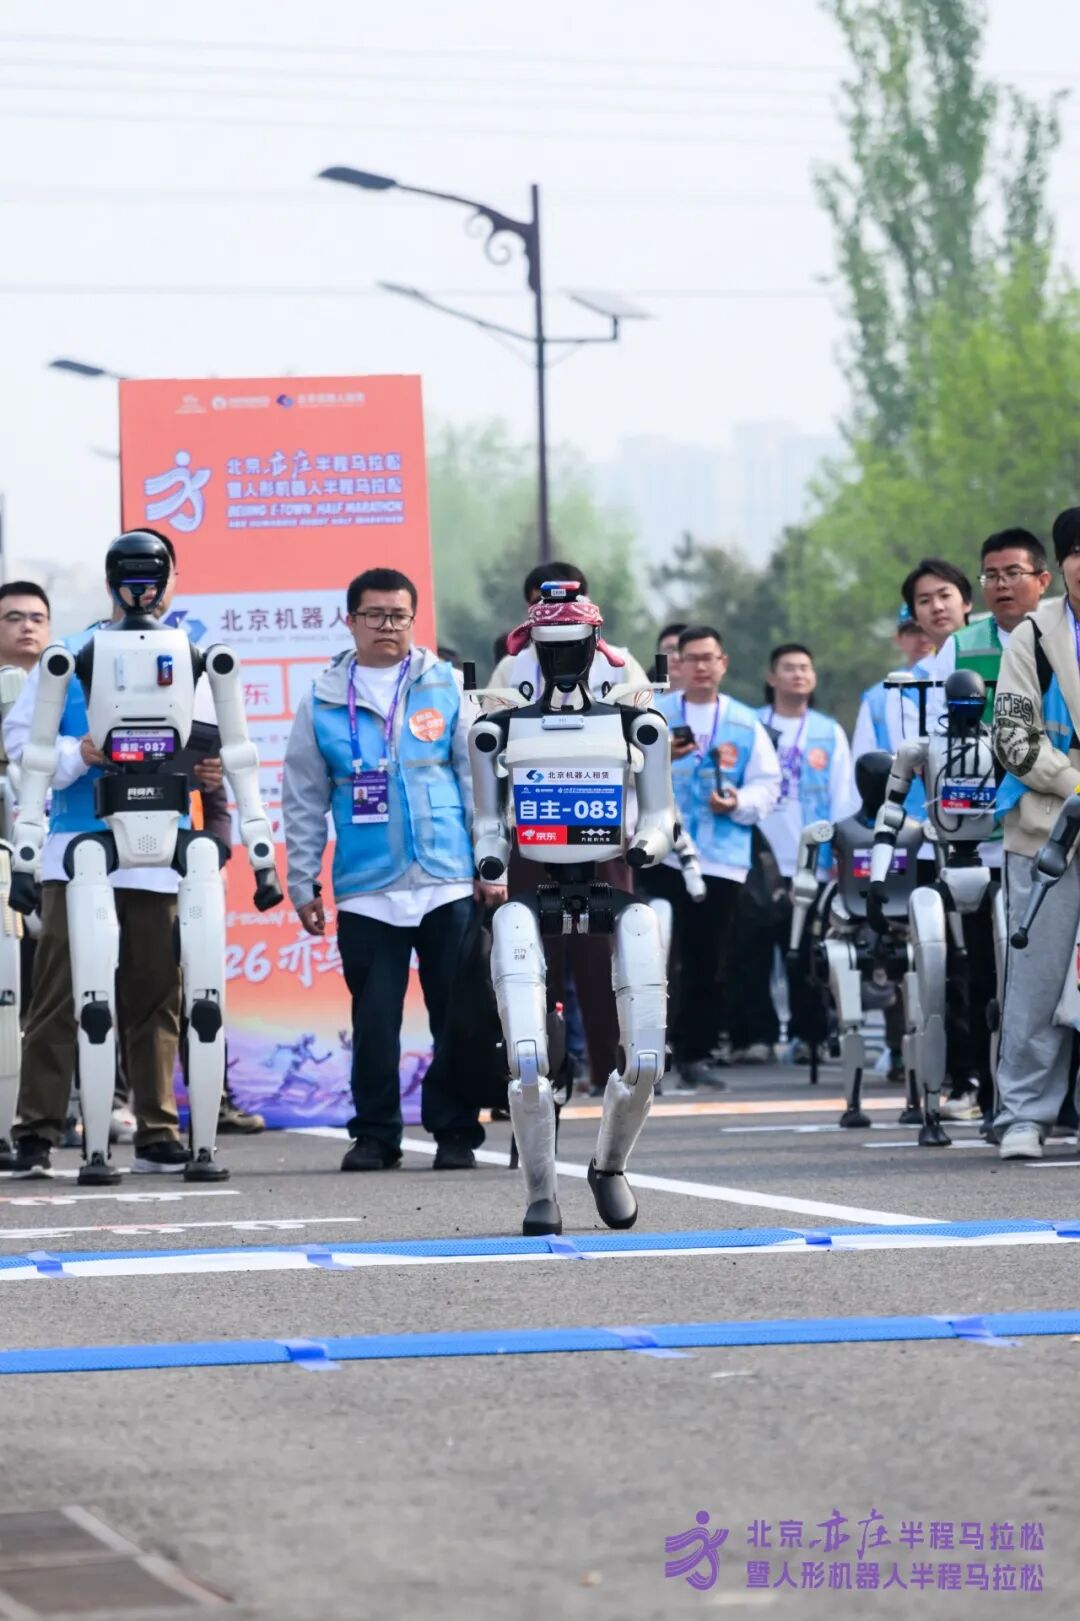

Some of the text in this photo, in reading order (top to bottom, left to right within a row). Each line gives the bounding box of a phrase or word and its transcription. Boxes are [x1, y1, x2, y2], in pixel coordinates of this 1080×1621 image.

[995, 692, 1034, 727] TES
[548, 771, 609, 779] 北京机器人租赁
[520, 800, 618, 819] 自主-083
